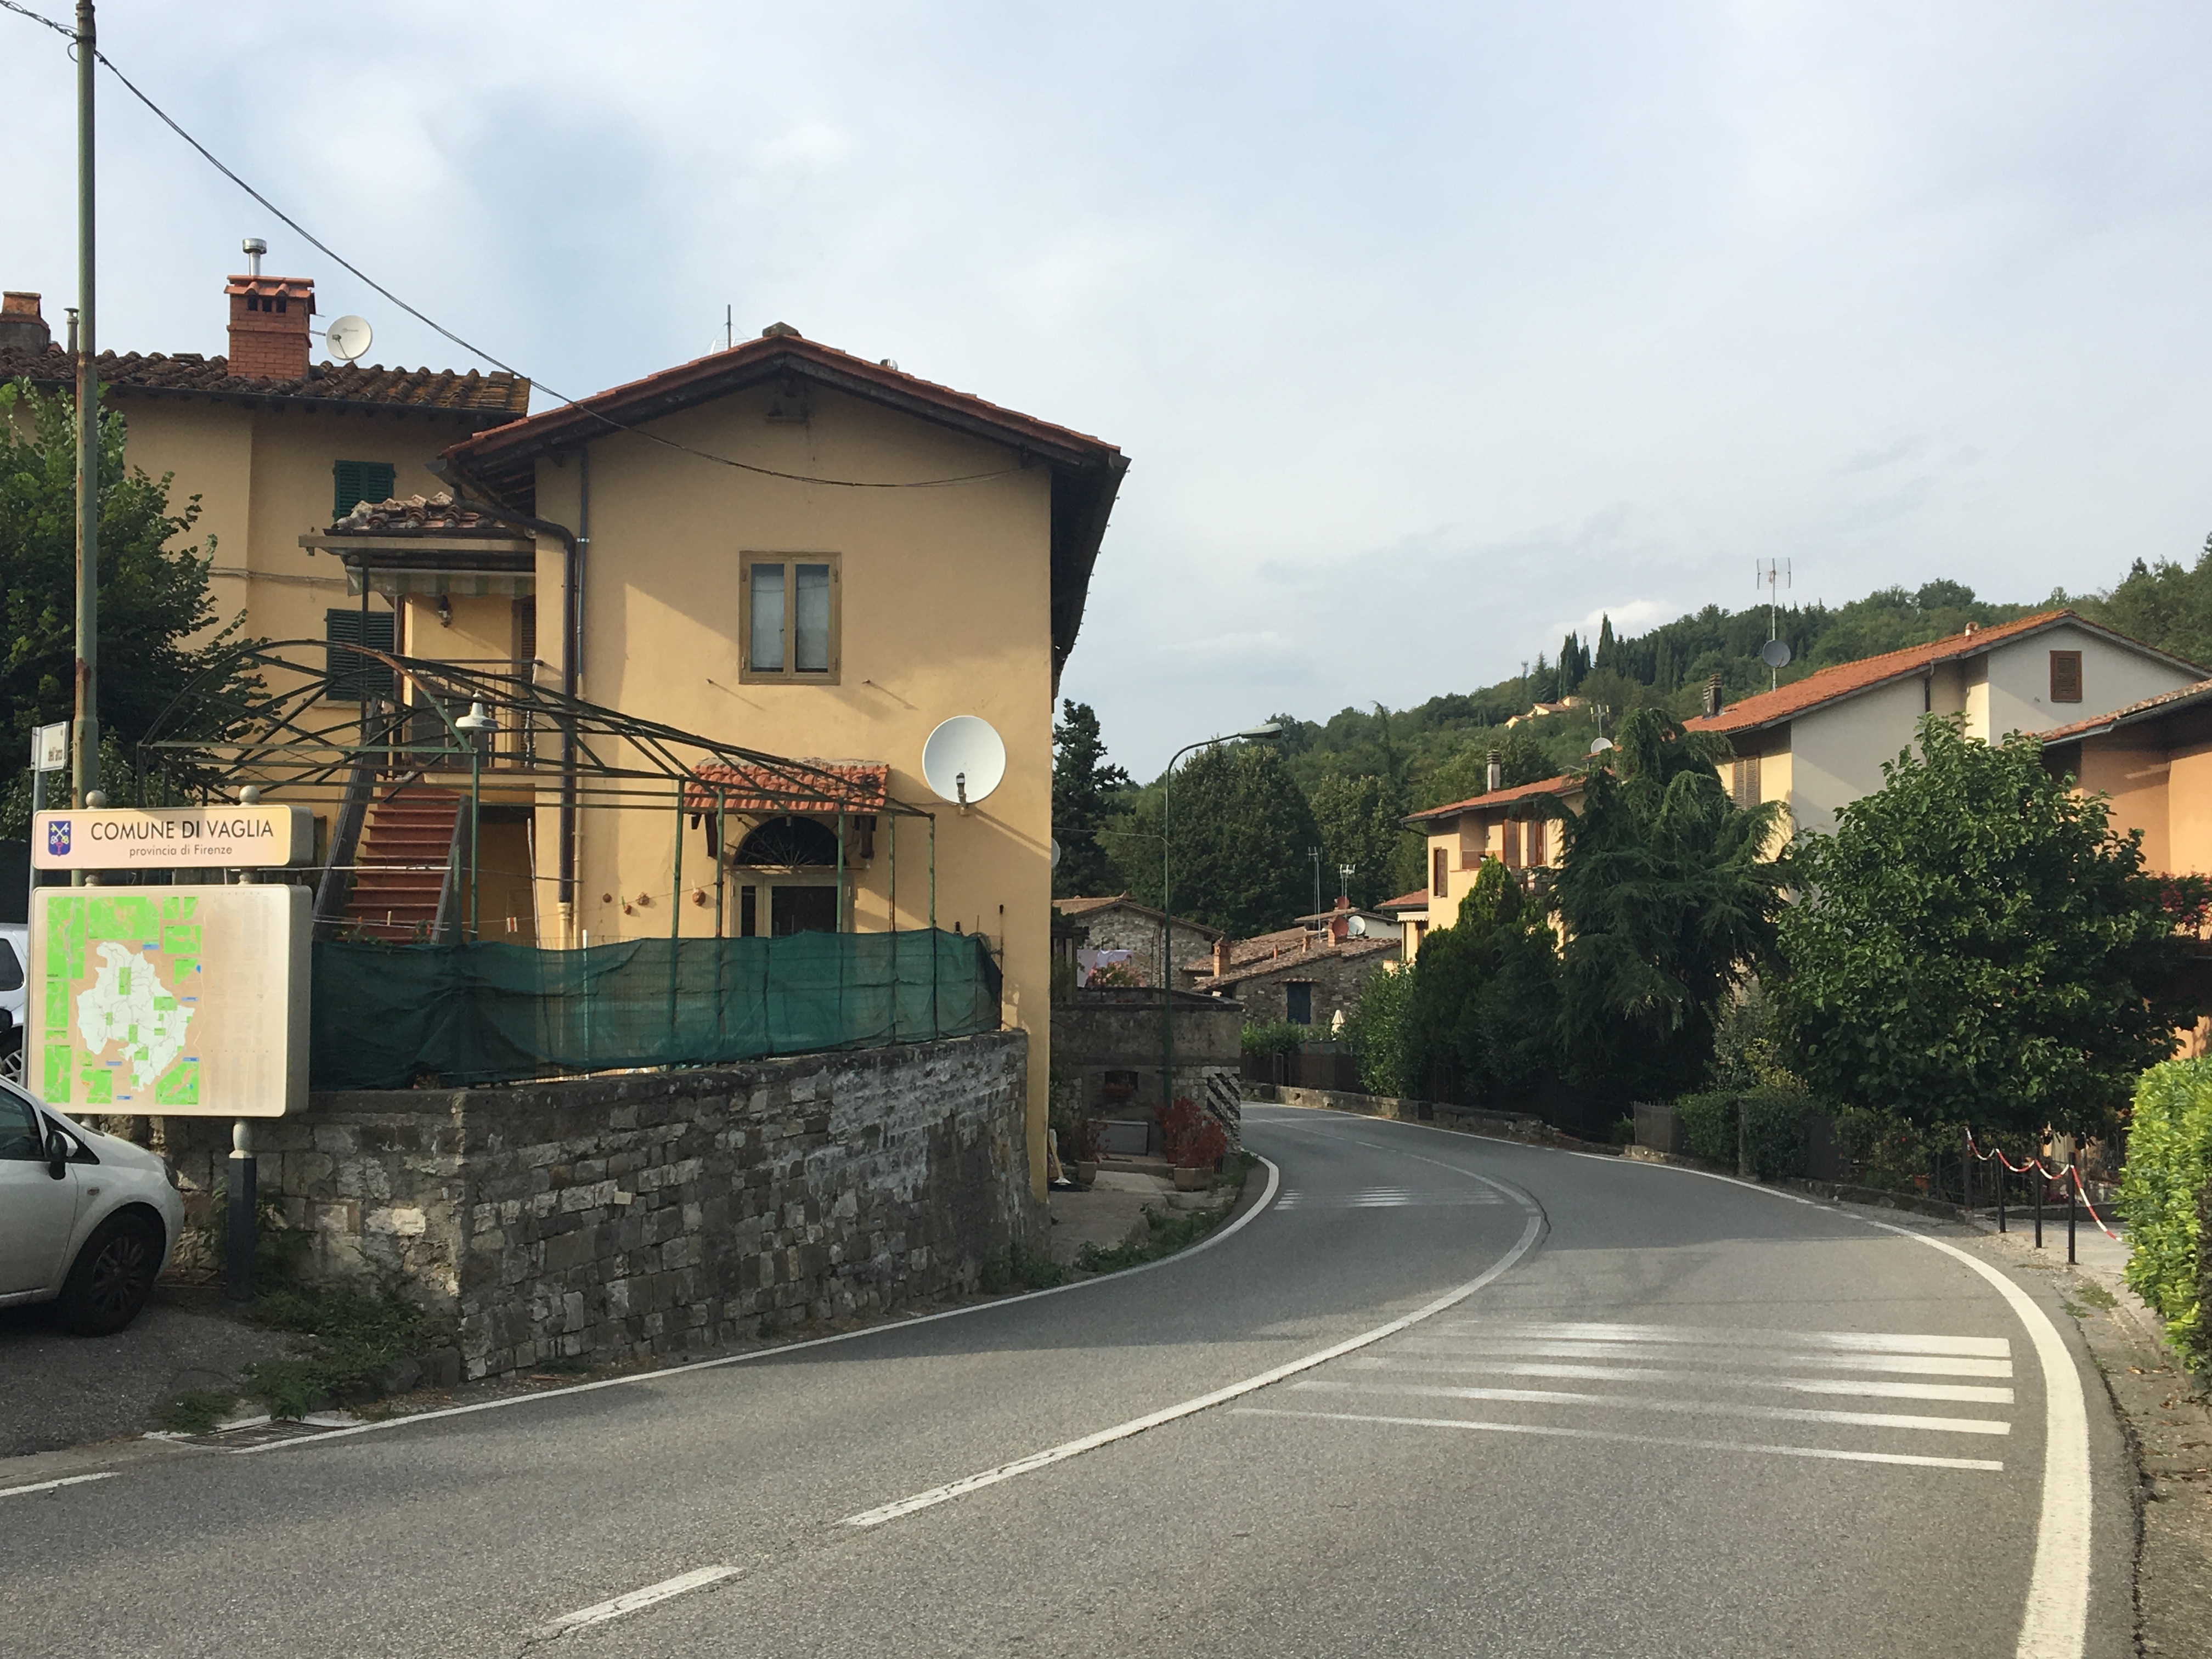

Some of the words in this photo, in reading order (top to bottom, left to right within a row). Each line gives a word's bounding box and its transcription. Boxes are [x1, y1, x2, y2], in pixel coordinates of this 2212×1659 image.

[91, 821, 174, 840] COMUNE
[182, 820, 200, 838] DI
[207, 819, 274, 838] VAGLIA
[129, 844, 177, 859] provincia
[180, 844, 190, 855] di
[194, 844, 233, 855] Firenze
